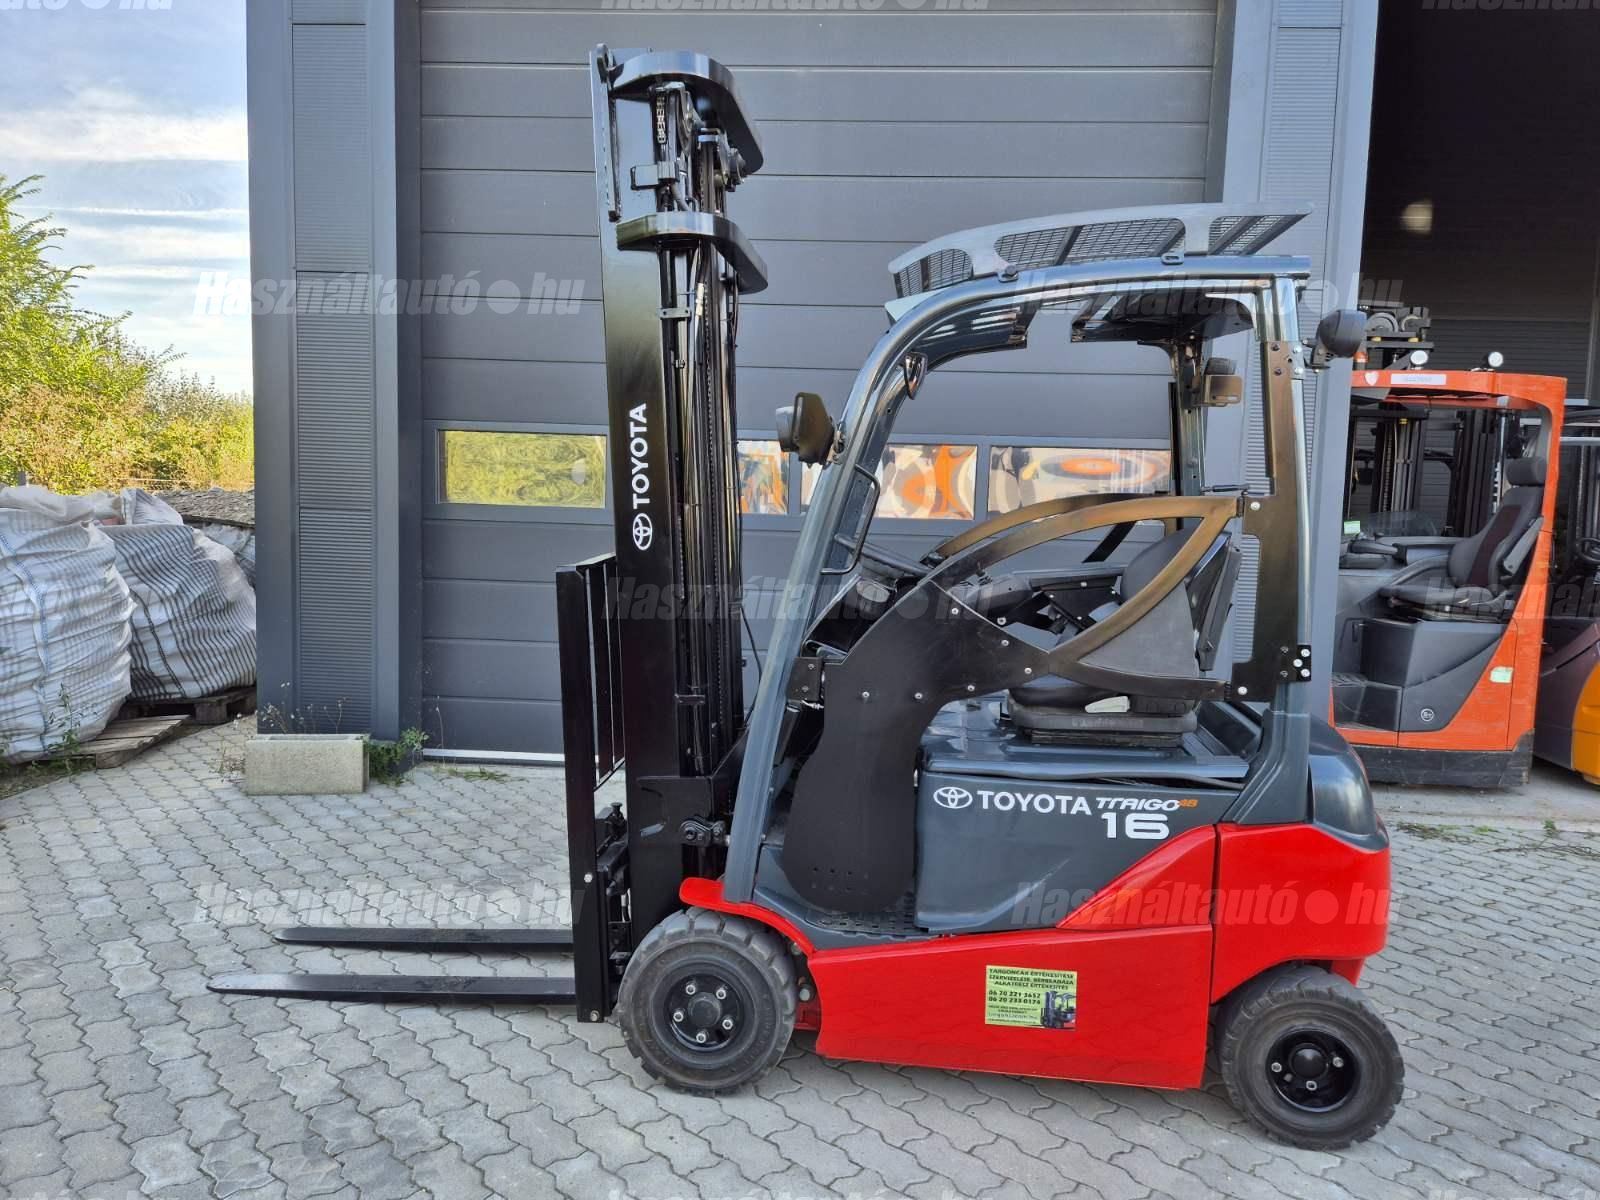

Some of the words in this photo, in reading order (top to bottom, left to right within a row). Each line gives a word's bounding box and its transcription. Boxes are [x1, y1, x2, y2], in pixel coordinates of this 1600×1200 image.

[629, 403, 651, 510] TOYOTA
[977, 790, 1092, 816] TOYOTA
[1101, 812, 1170, 840] 16
